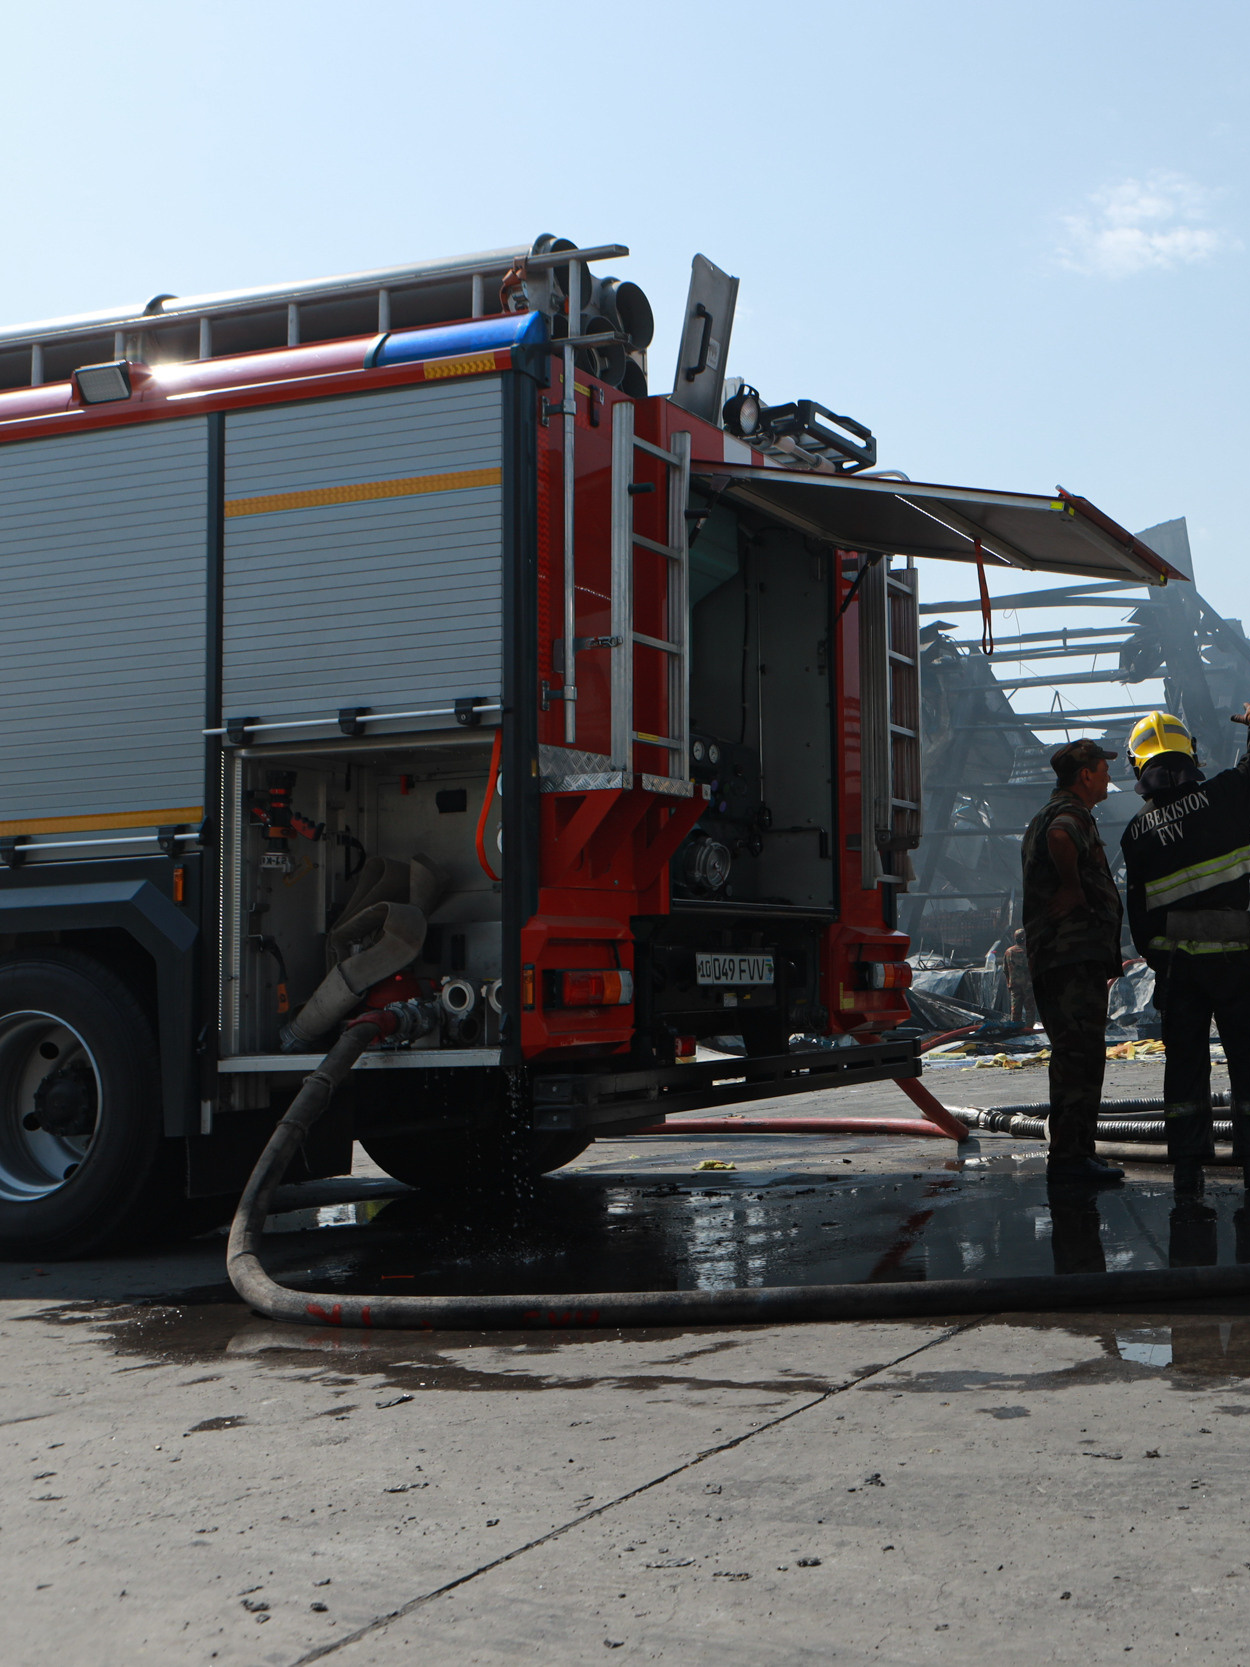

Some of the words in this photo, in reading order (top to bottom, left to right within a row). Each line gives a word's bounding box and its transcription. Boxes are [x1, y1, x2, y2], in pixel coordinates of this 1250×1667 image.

[1156, 821, 1184, 846] FVV
[700, 960, 711, 977] 10
[713, 958, 735, 980] 049
[739, 958, 765, 980] FVV
